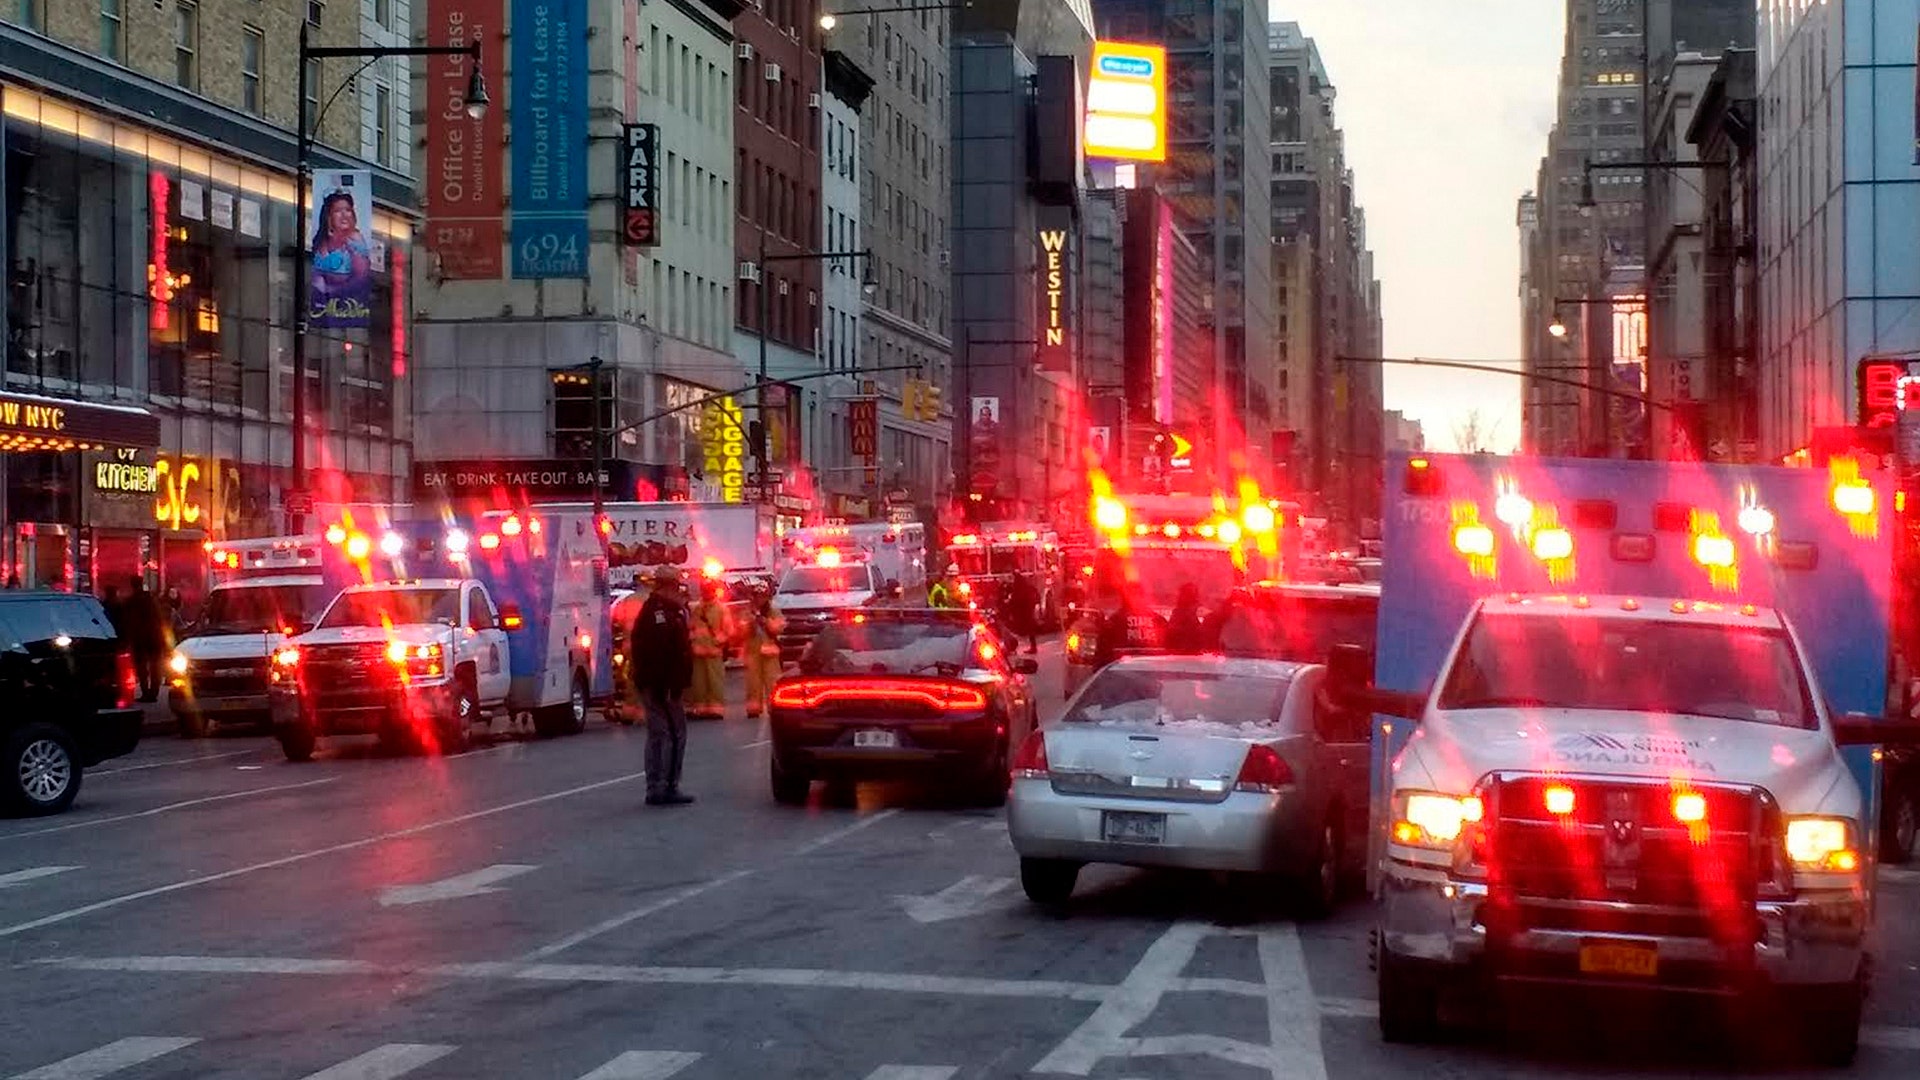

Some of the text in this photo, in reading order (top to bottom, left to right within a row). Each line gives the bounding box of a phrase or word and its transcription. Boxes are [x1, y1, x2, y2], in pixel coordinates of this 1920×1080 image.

[443, 12, 463, 201] Office for Lease
[530, 5, 548, 199] Billboard for Lease
[629, 128, 648, 207] PARK
[521, 233, 578, 262] 694
[1040, 231, 1066, 346] WESTIN
[26, 404, 65, 431] NYC
[723, 396, 743, 503] LUGGAGE
[96, 461, 157, 492] KITCHEN
[423, 473, 447, 486] EAT
[456, 472, 498, 485] DRINK
[505, 472, 538, 485] TAKE
[541, 472, 567, 485] OUT
